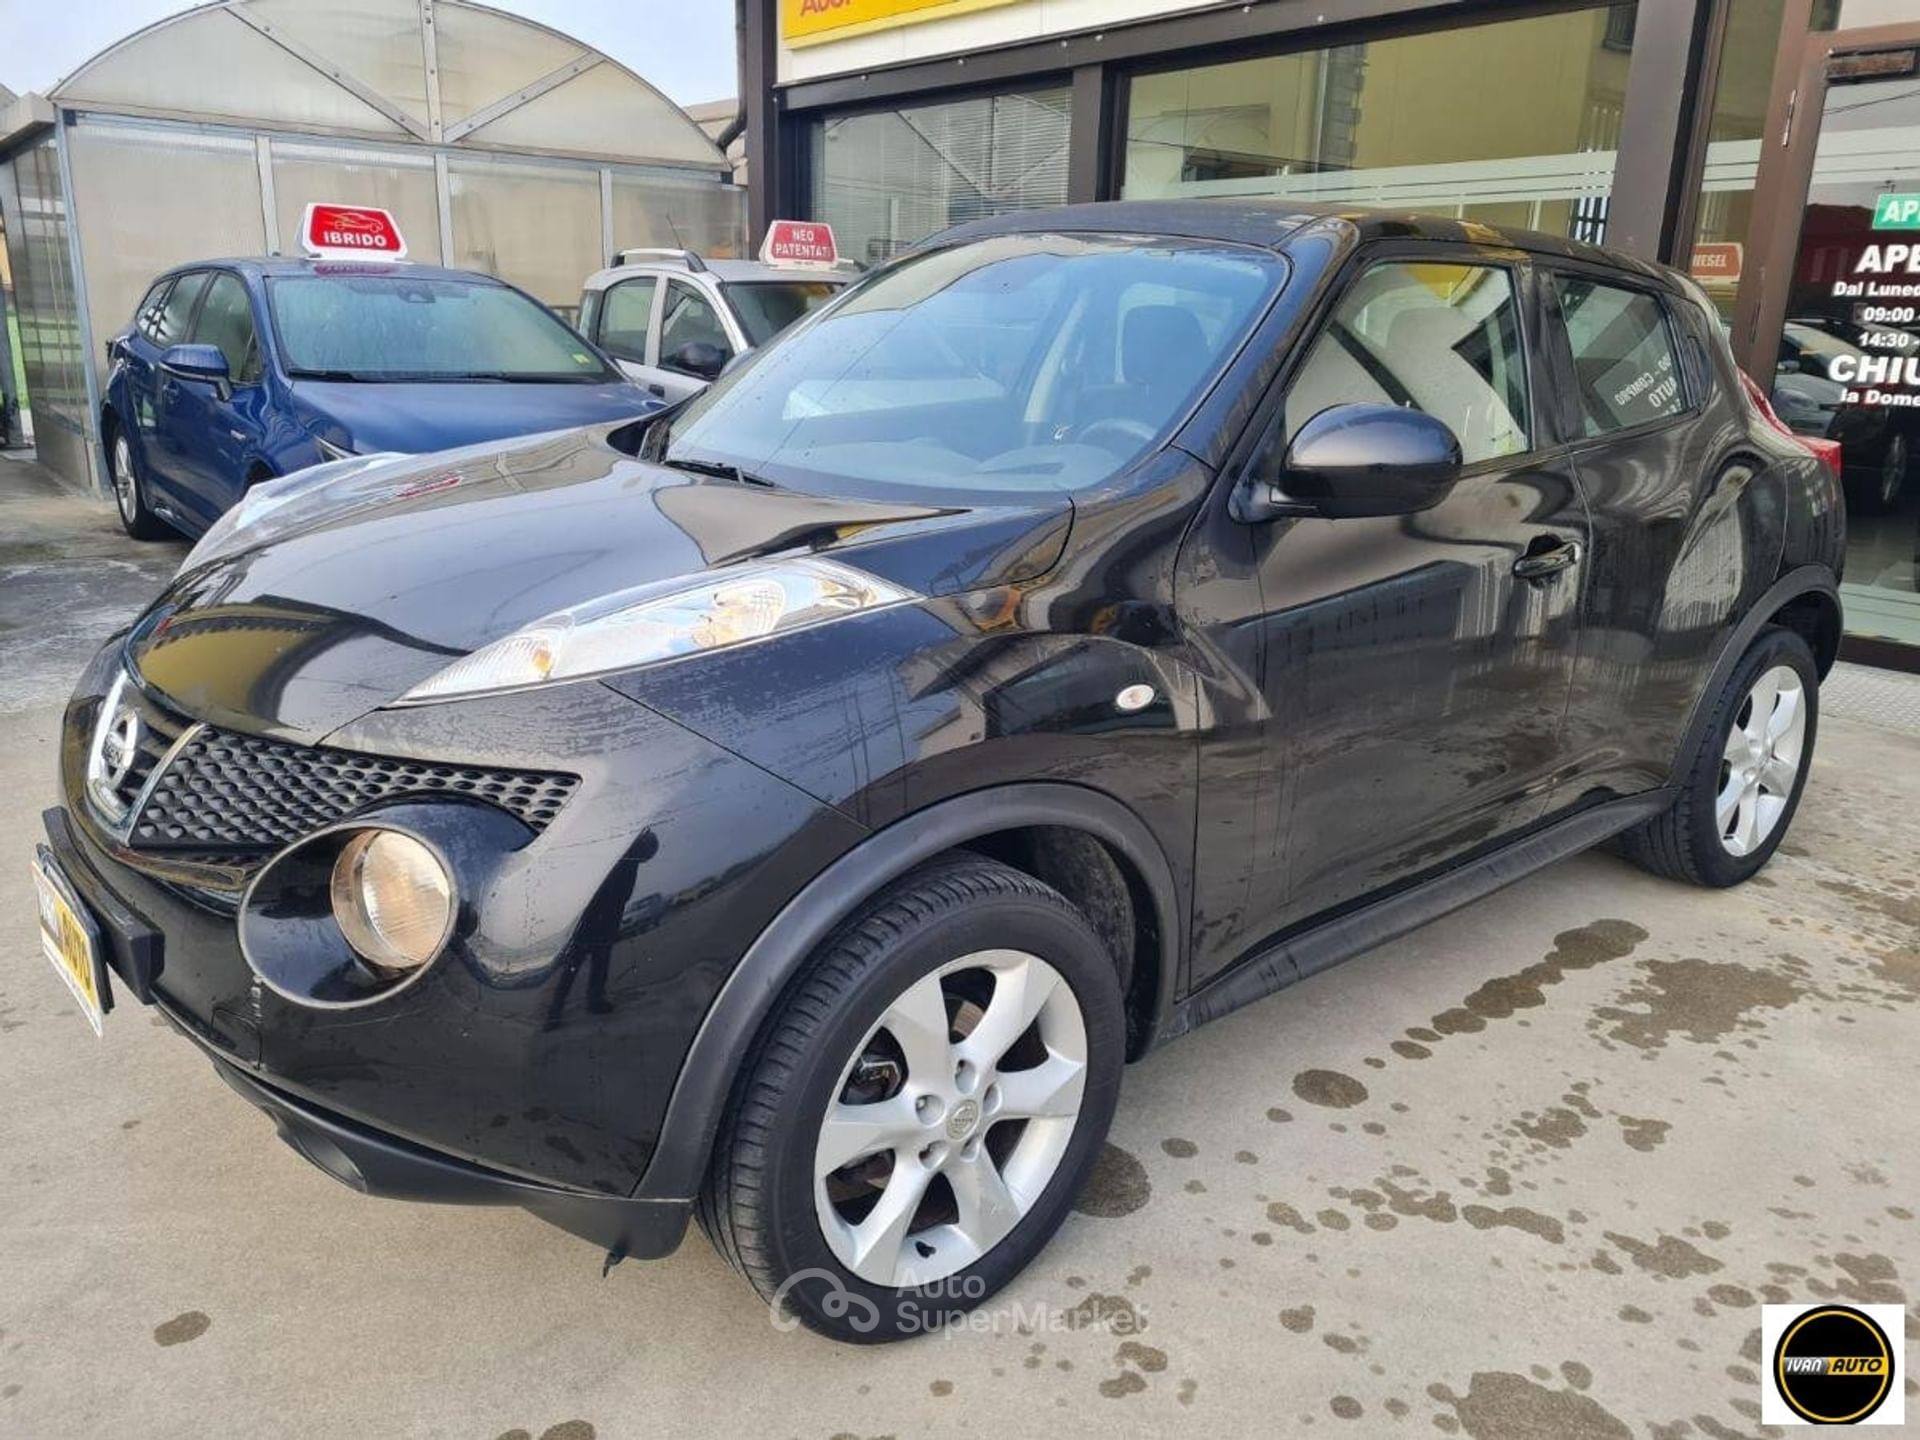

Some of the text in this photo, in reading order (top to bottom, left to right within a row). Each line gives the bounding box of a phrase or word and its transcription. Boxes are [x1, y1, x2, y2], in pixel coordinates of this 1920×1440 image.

[1881, 200, 1920, 222] AP
[323, 231, 387, 247] IBRIDO
[792, 229, 815, 242] NEO
[1832, 281, 1864, 296] Dal
[1863, 306, 1915, 323] 09:00
[1859, 332, 1909, 348] 14:30
